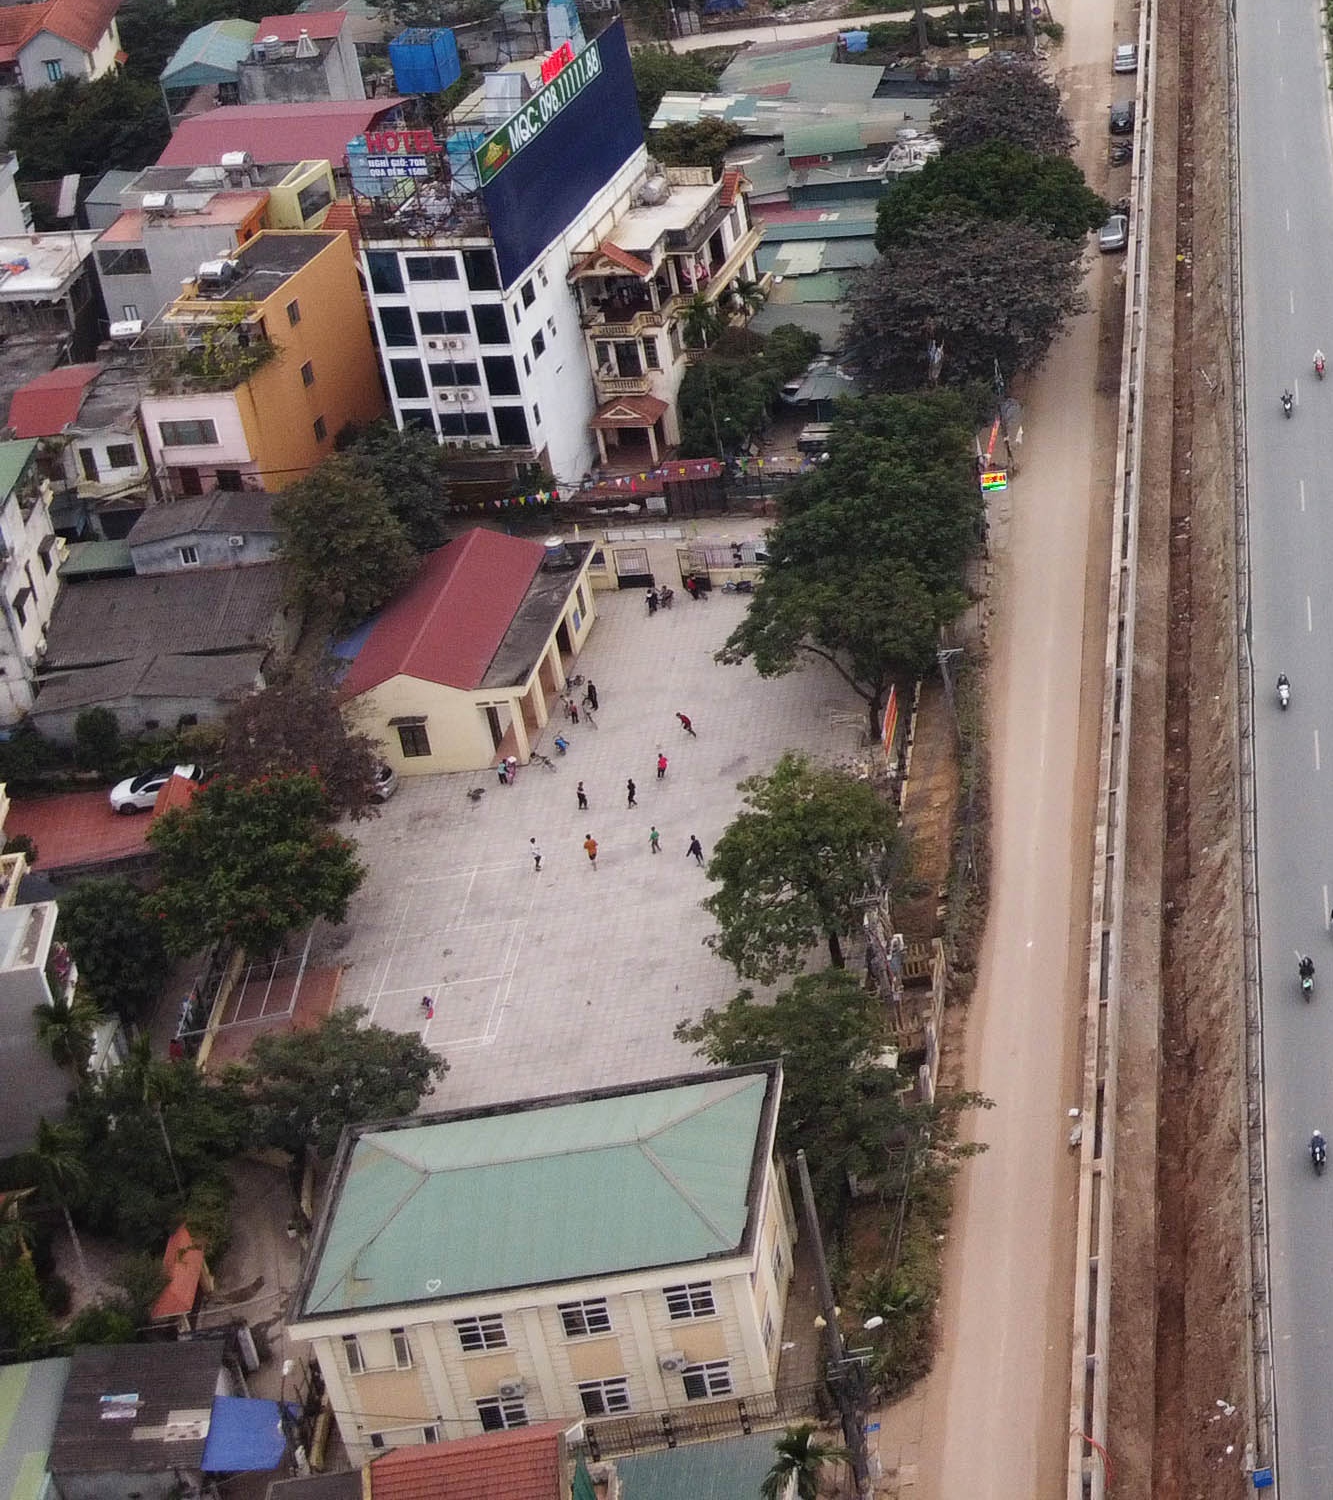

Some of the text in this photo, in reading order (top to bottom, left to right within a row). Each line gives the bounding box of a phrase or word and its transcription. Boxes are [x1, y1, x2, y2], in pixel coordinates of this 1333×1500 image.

[508, 107, 541, 152] MQC:
[539, 47, 599, 122] 098.11111.88
[364, 129, 443, 153] HOTEL
